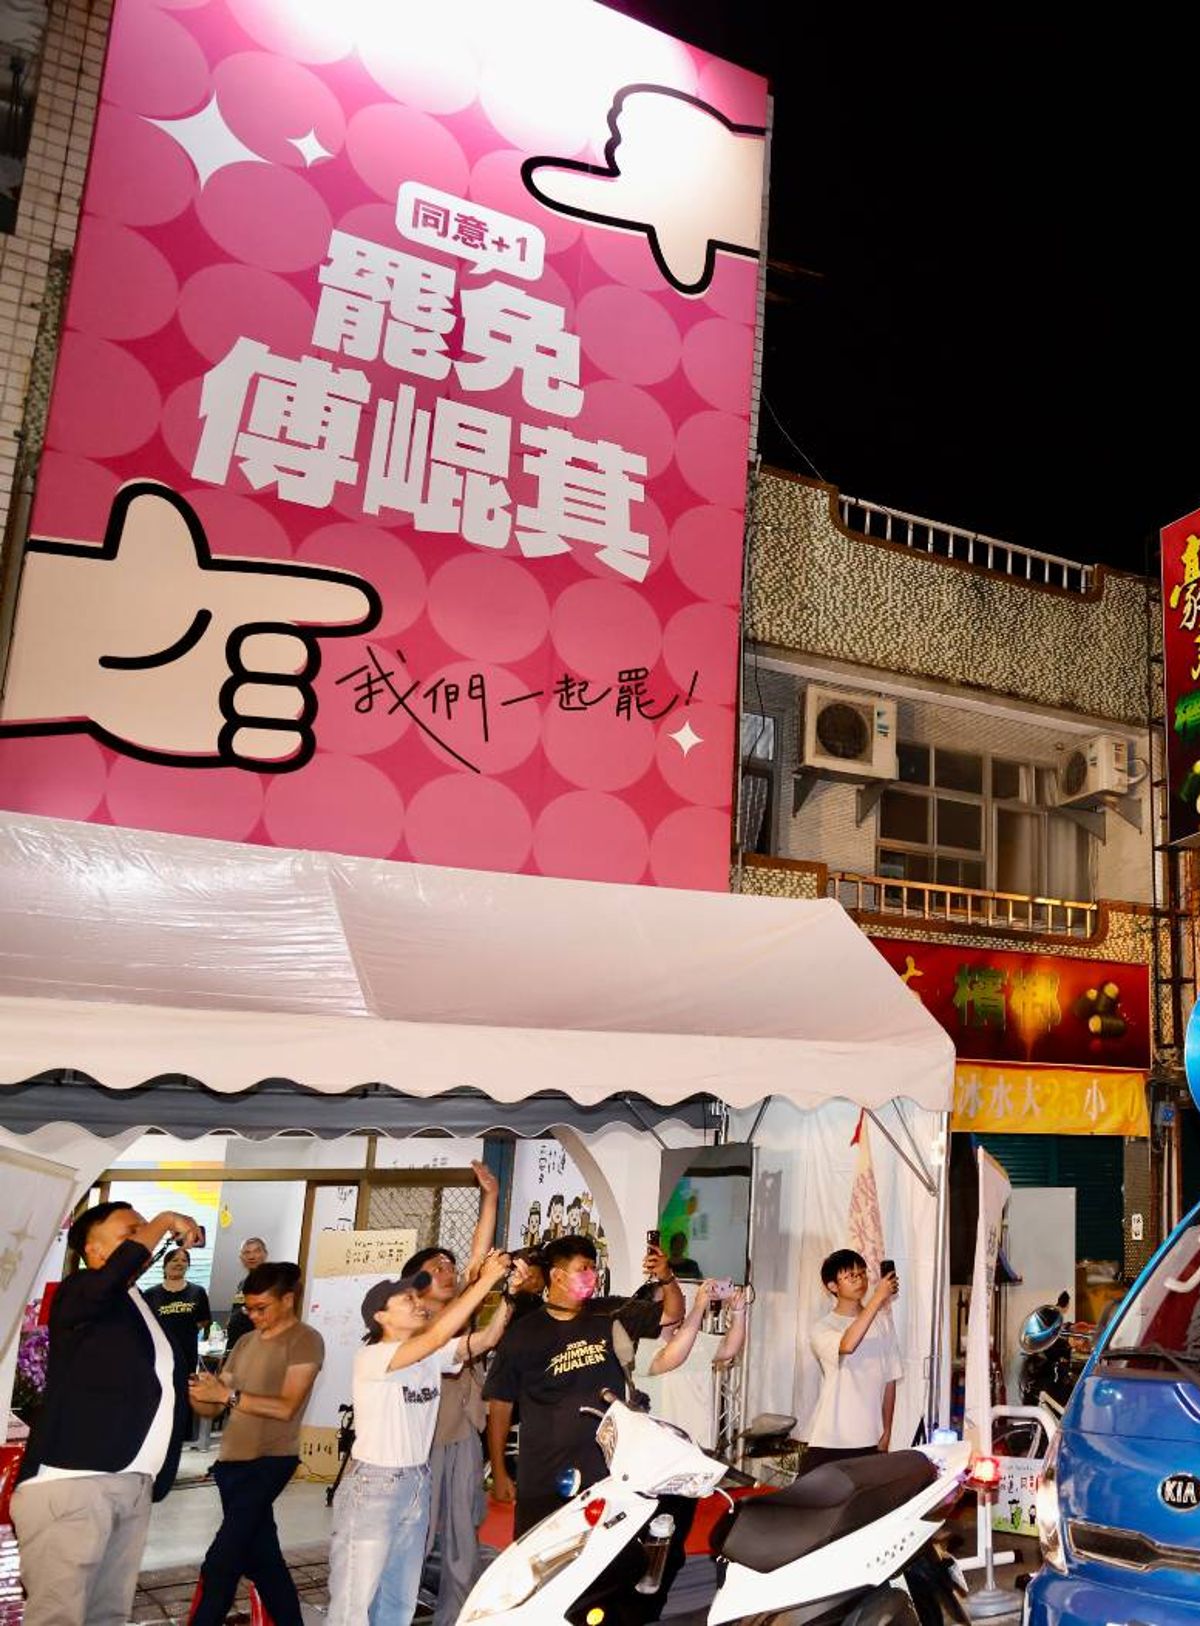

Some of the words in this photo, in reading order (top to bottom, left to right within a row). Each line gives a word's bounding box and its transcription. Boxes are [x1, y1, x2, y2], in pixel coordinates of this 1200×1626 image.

[410, 197, 531, 263] 同意+1
[311, 229, 585, 418] 罷免
[190, 336, 651, 583] 傅崐萁
[549, 1344, 607, 1364] SHIMMER
[553, 1353, 605, 1376] HUALIEN
[1164, 1480, 1198, 1504] KIA
